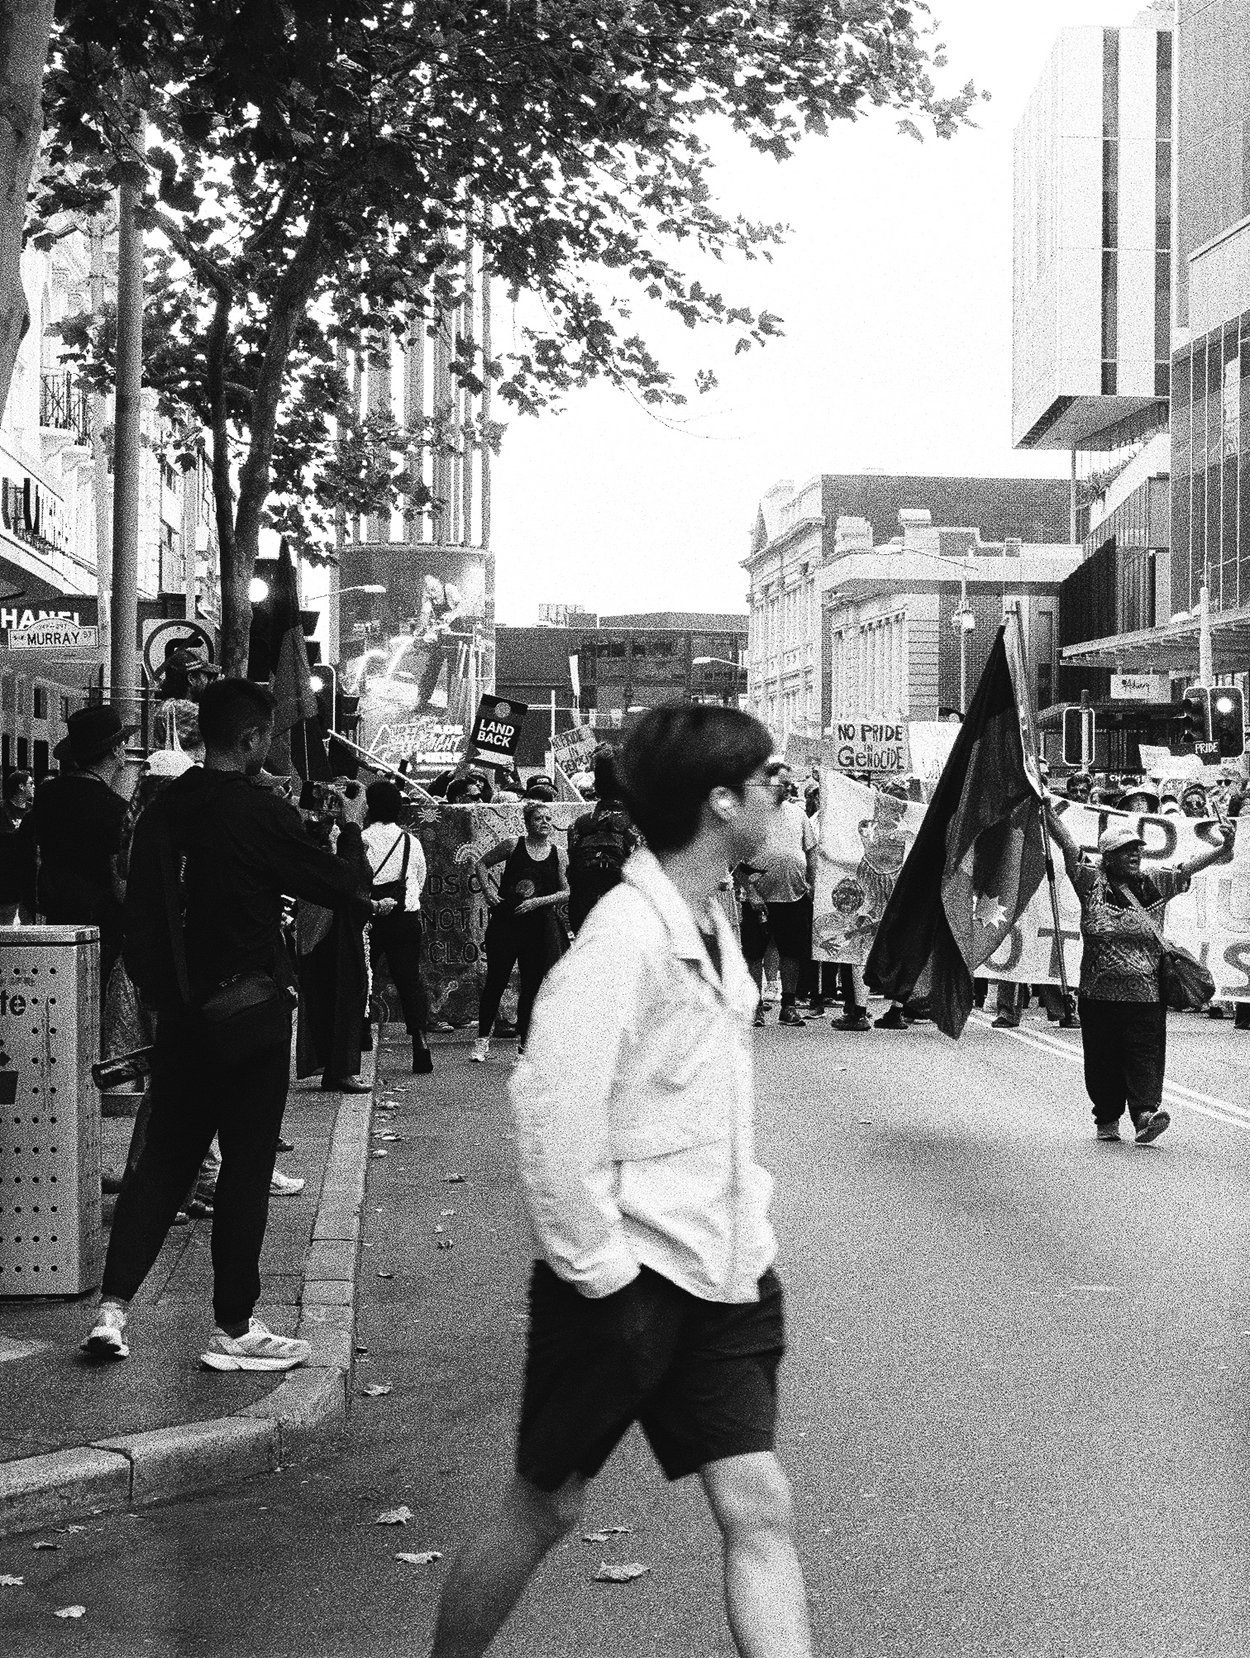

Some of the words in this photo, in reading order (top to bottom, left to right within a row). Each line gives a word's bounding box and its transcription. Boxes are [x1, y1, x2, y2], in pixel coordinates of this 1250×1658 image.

[27, 632, 79, 645] MURRAY
[479, 719, 515, 737] LAND
[837, 724, 856, 741] NO
[860, 724, 903, 742] PRIDE
[476, 731, 511, 748] BACK
[1195, 742, 1219, 754] PRIDE
